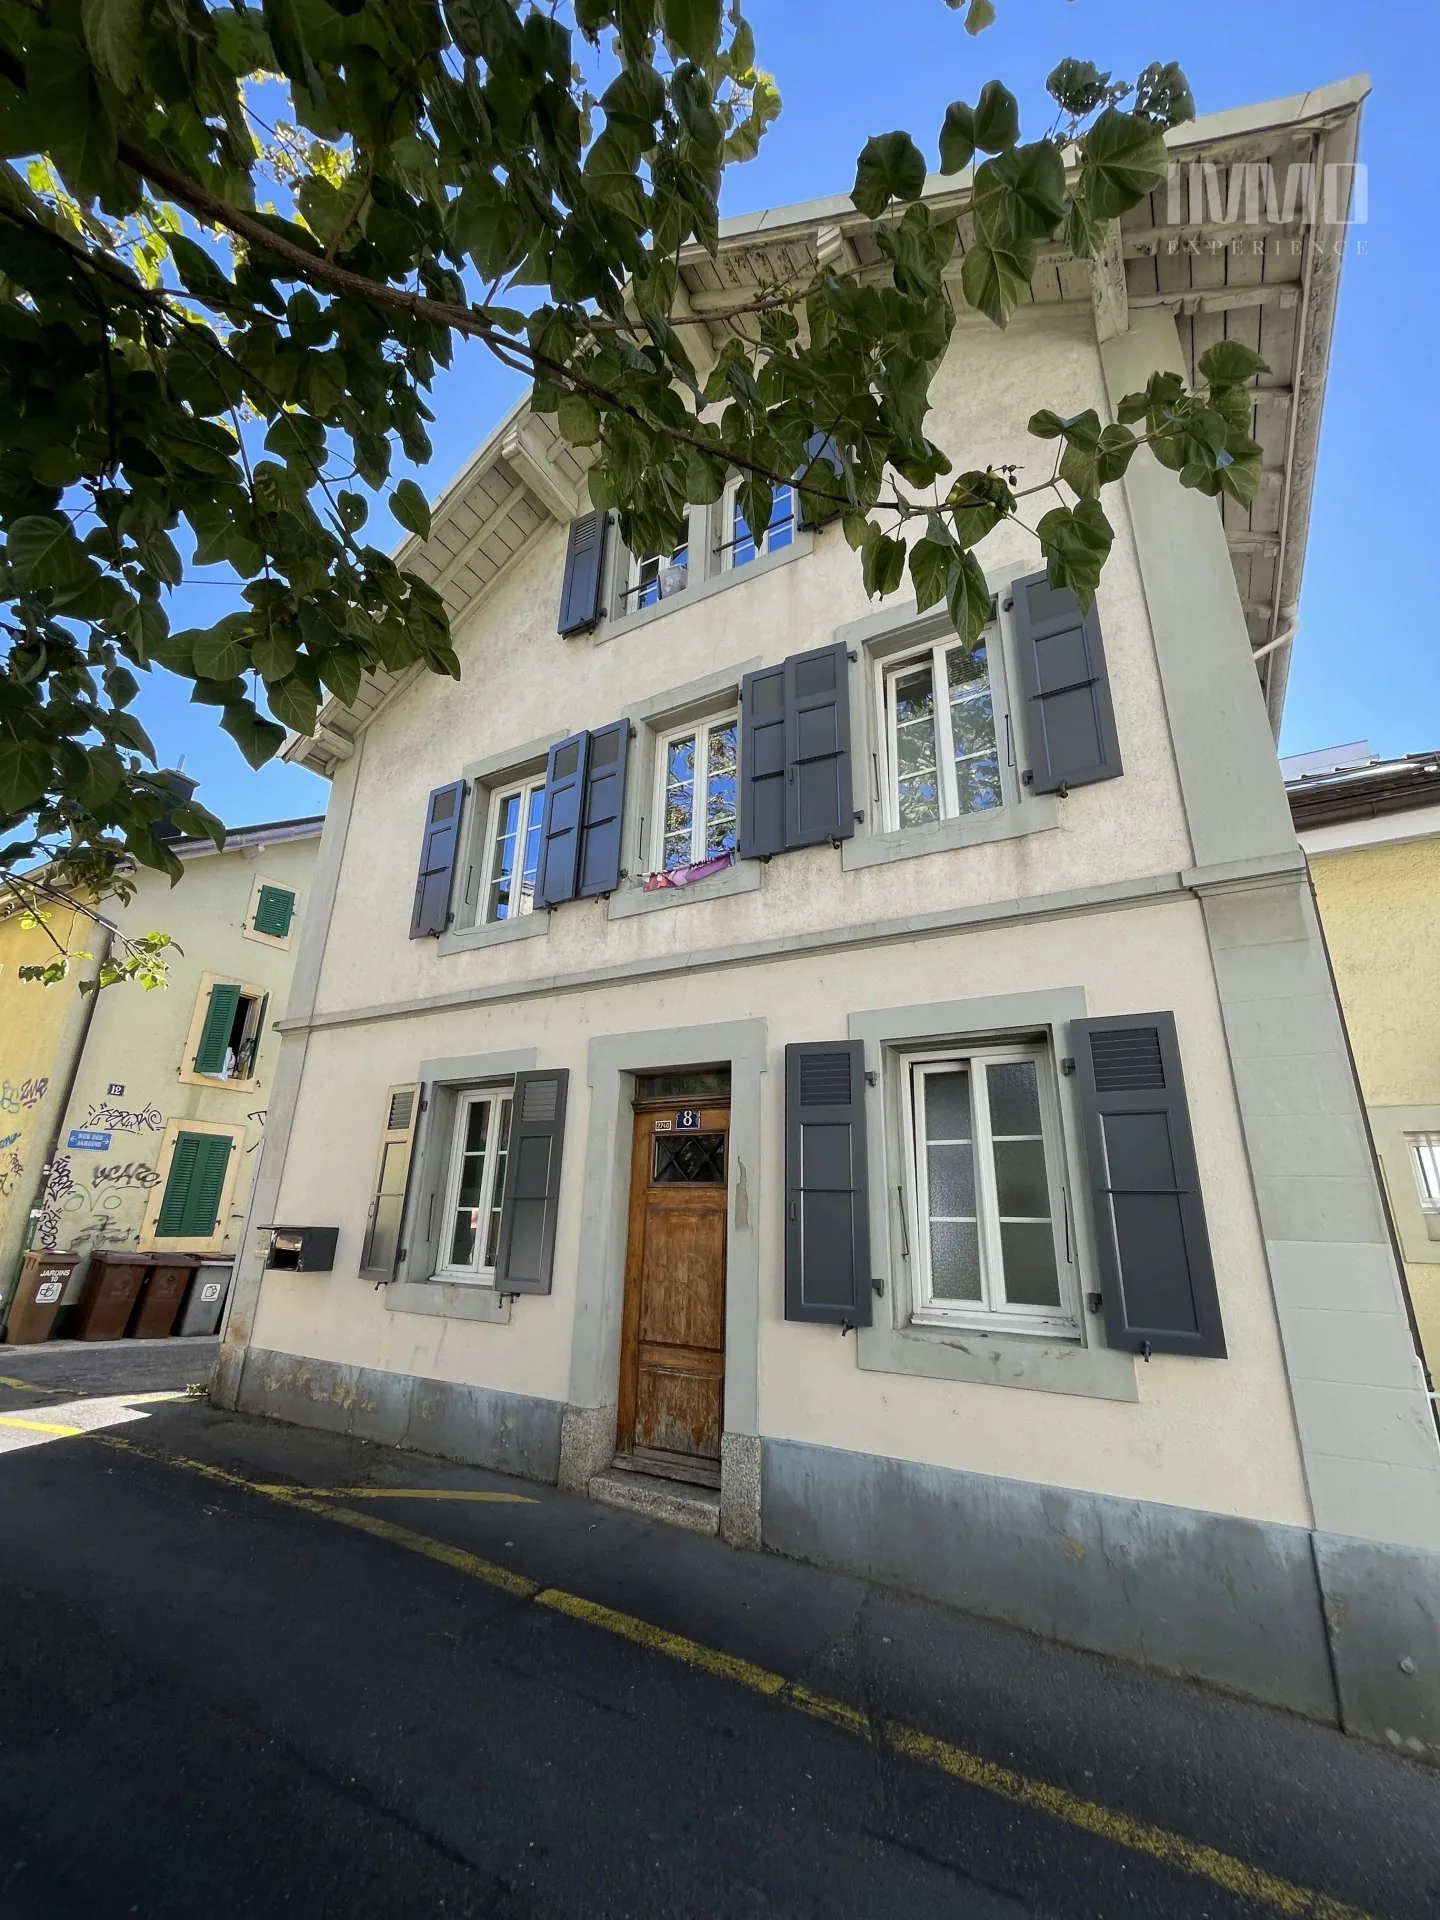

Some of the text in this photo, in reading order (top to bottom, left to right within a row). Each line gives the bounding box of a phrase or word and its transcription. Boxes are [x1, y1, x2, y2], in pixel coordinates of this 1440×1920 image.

[110, 1085, 122, 1095] 12
[682, 1110, 693, 1126] 8
[40, 1269, 71, 1277] JARDINS
